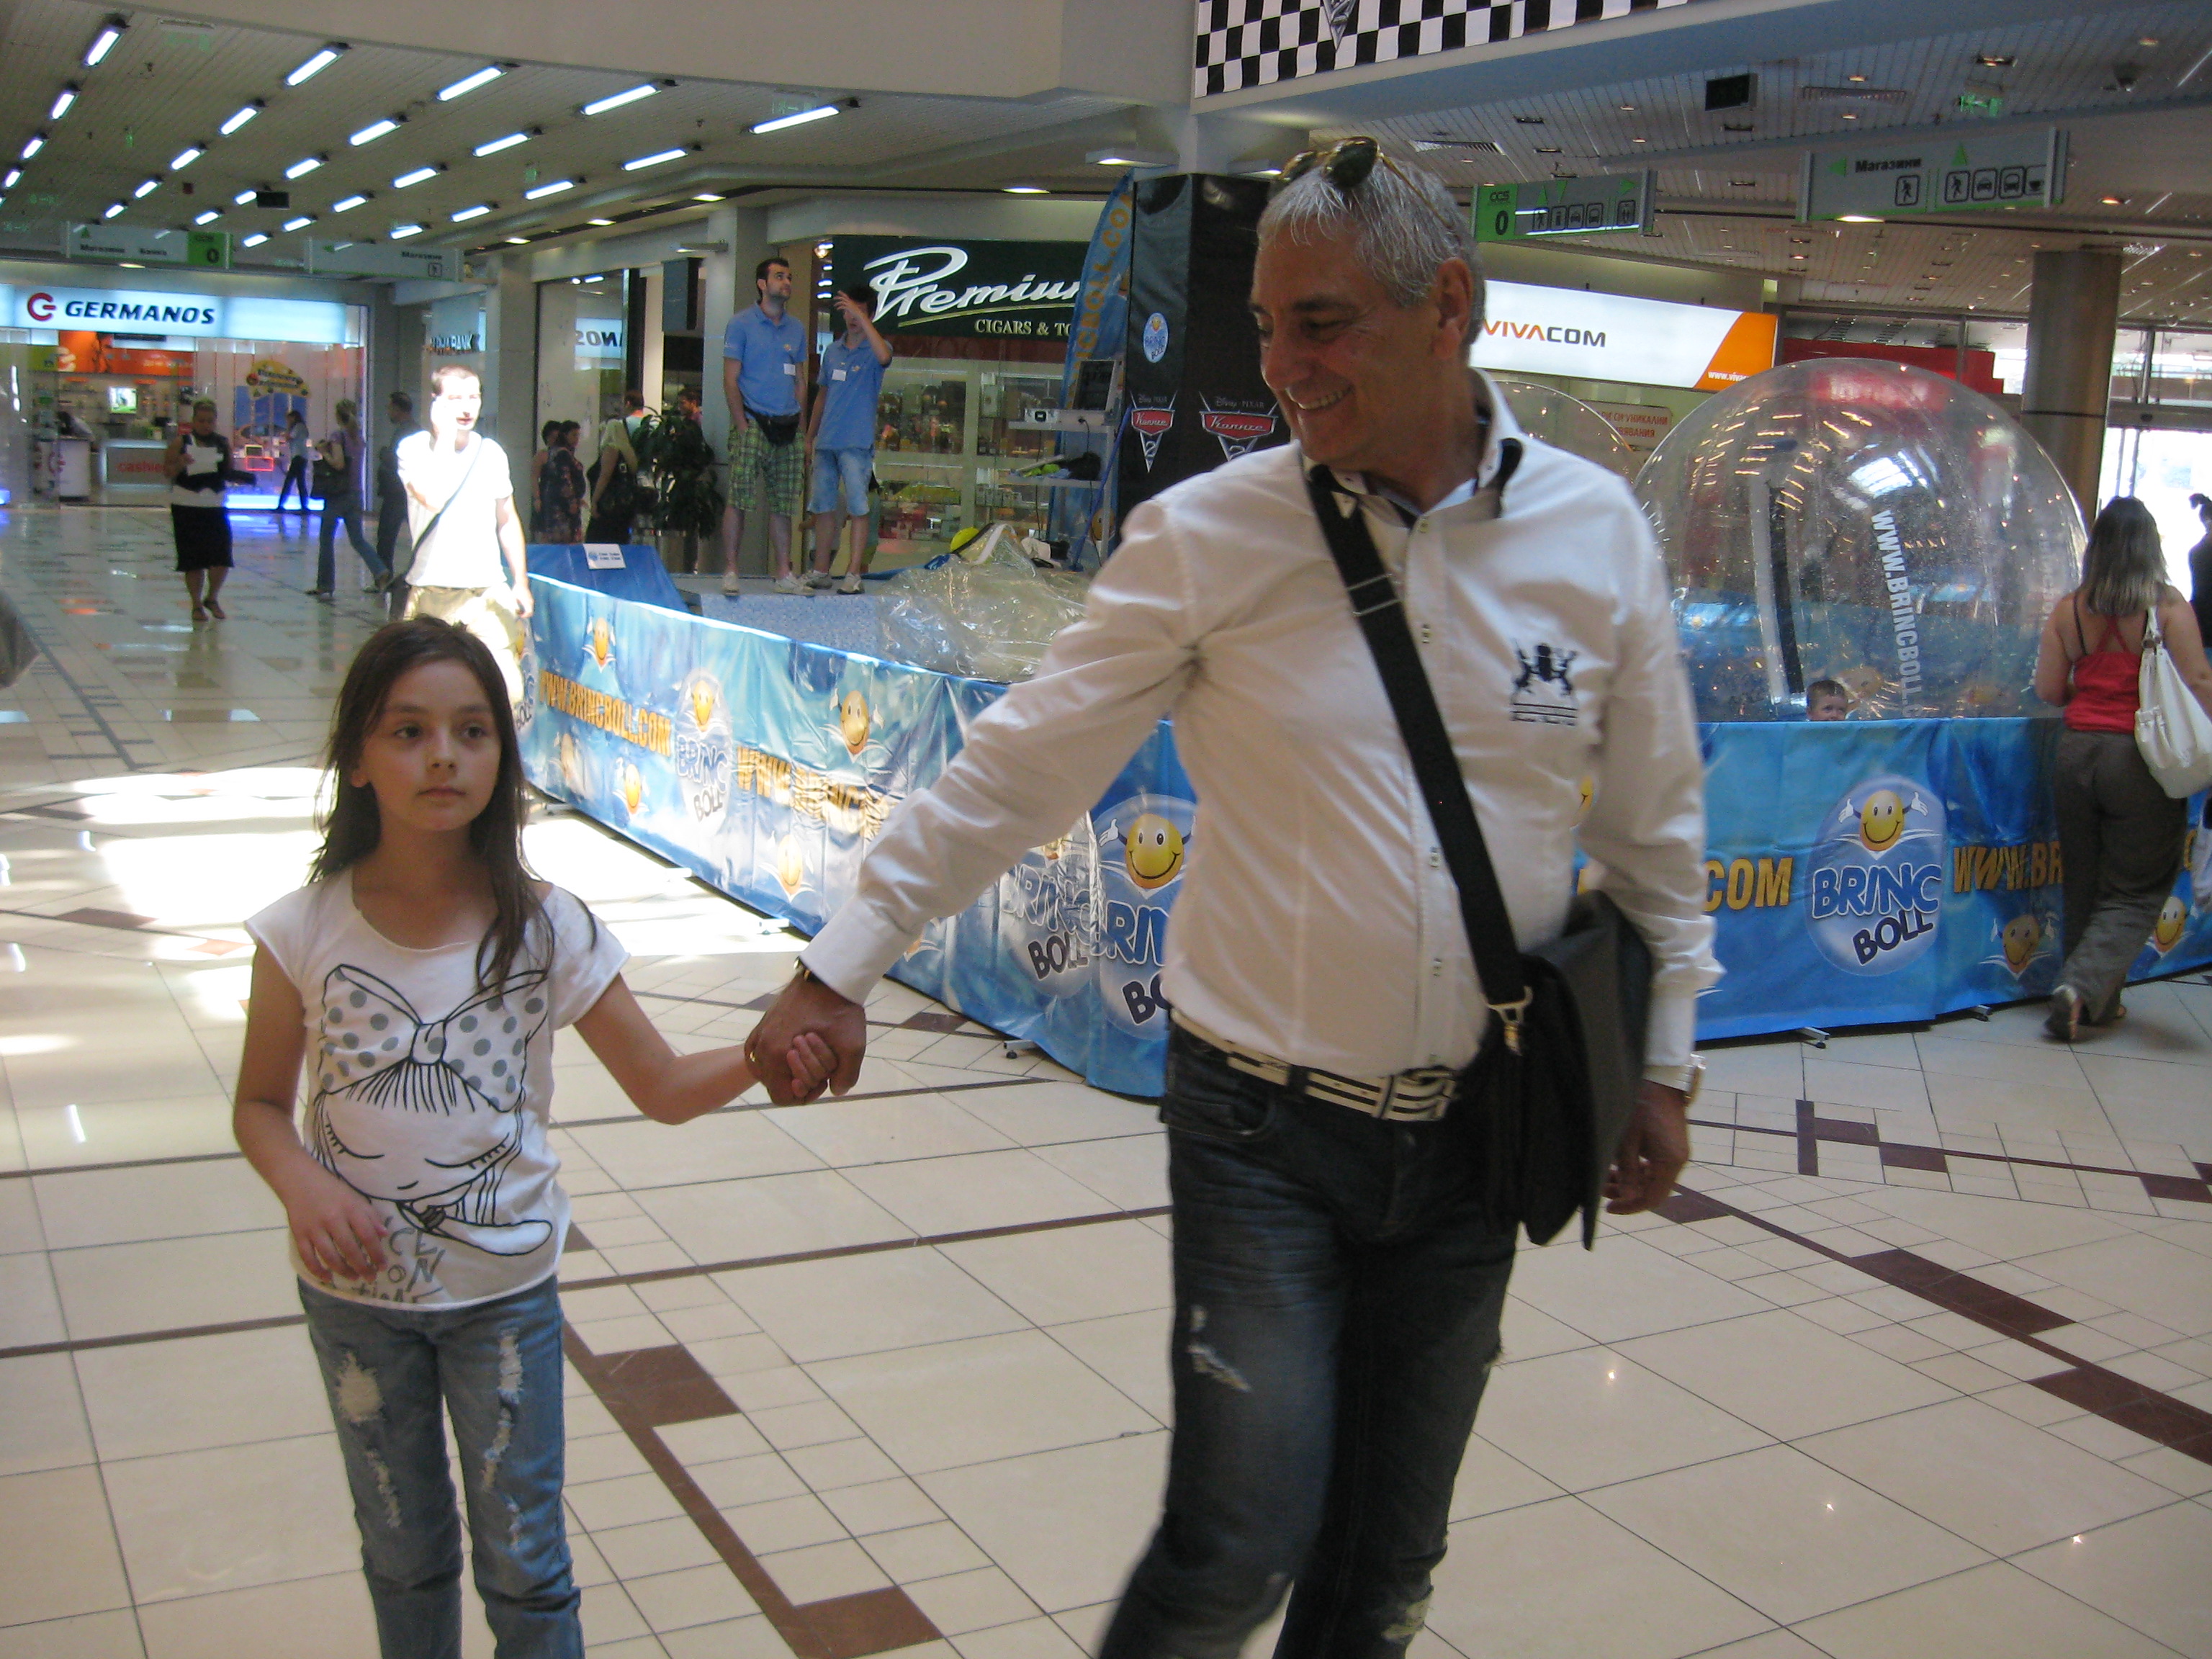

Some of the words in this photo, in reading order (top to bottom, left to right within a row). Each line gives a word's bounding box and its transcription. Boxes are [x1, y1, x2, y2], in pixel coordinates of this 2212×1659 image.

[1855, 158, 1921, 173] Магазини
[863, 246, 1081, 323] Premiu
[66, 301, 215, 324] GERMANOS
[974, 319, 1032, 336] CIGARS
[1037, 322, 1049, 336] &
[1483, 320, 1606, 348] VIVACOM
[1707, 371, 1750, 382] www.viva
[693, 785, 724, 822] BOLL
[1954, 841, 2064, 893] WWW.BR
[1811, 862, 1943, 920] BRINC
[1853, 909, 1934, 966] BOLL
